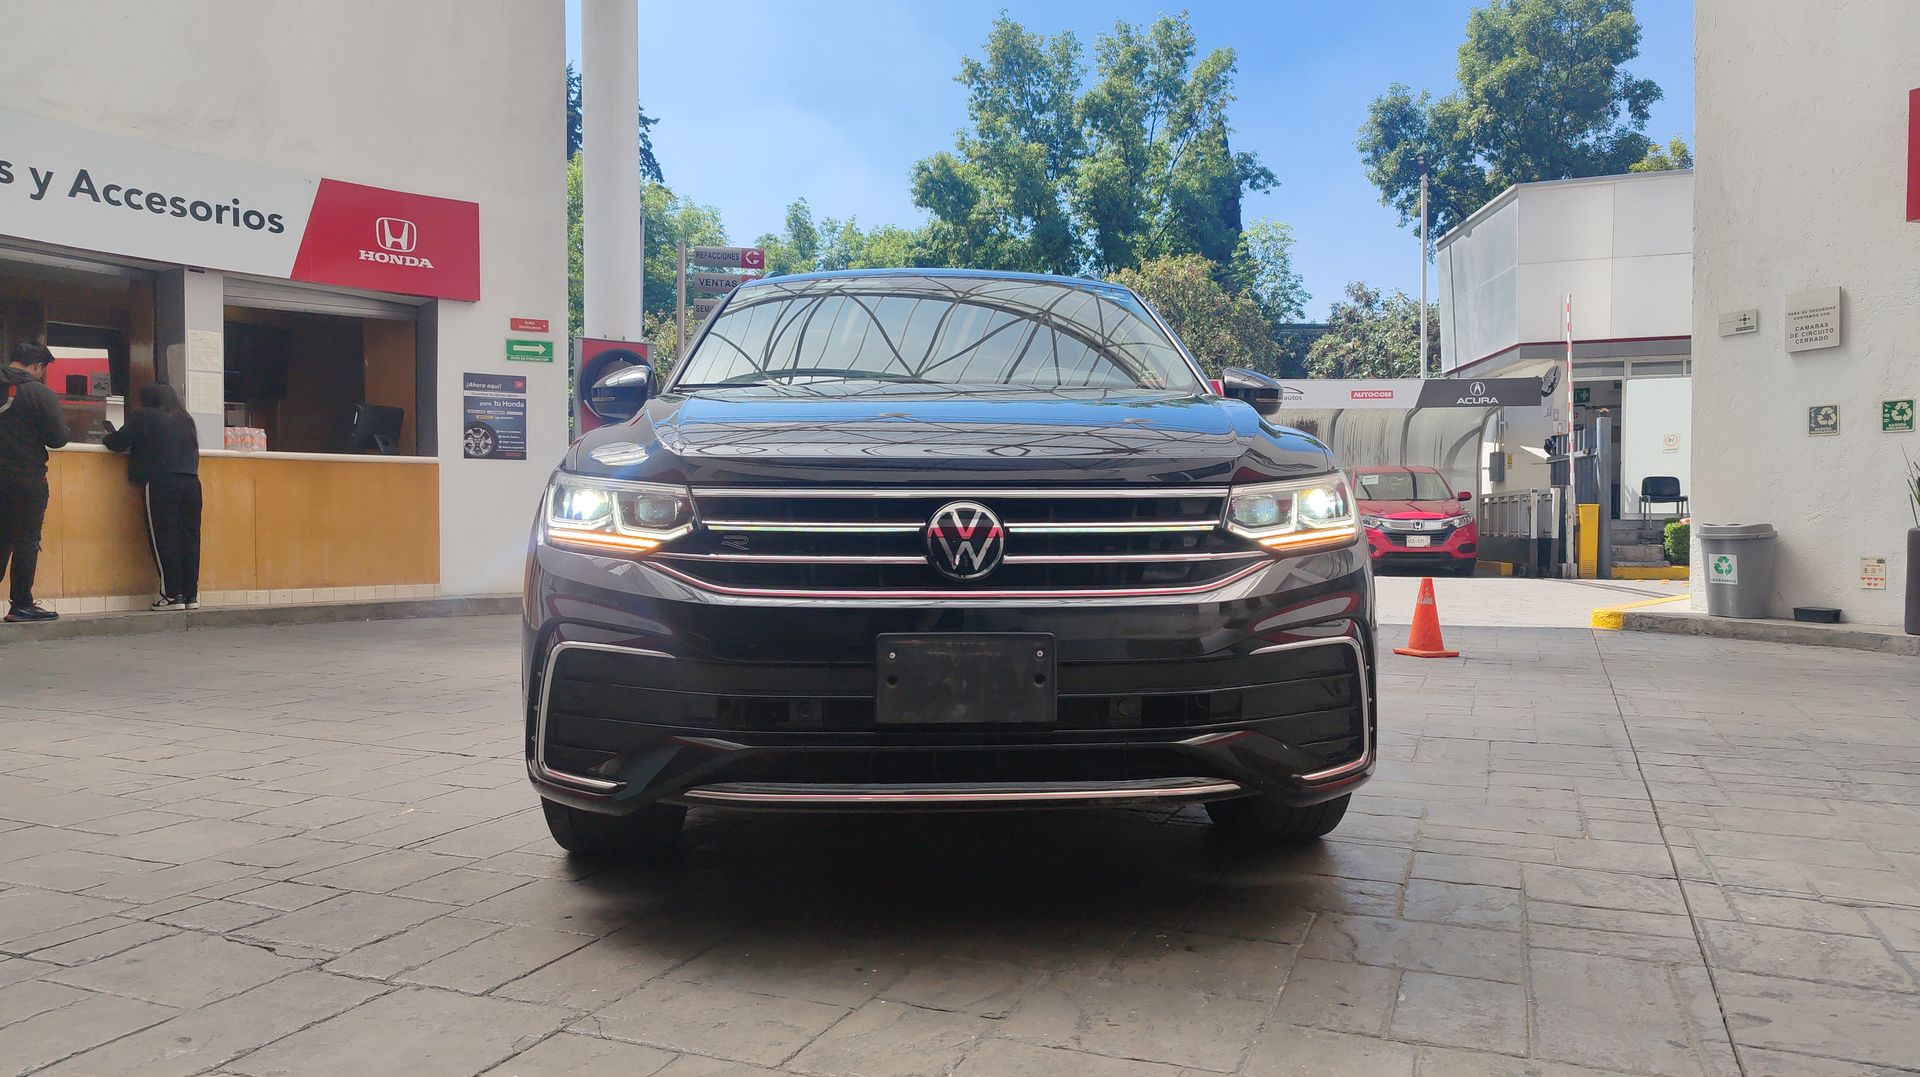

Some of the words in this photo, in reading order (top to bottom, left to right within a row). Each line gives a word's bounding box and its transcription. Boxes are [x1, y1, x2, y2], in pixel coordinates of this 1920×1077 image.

[29, 167, 54, 201] y
[67, 168, 285, 234] Accesorios
[358, 249, 435, 269] HONDA
[695, 251, 740, 261] REFACCIONES
[699, 278, 738, 288] VENTAS
[695, 304, 715, 313] SEMI
[1809, 305, 1837, 314] SEGURIDAD
[1793, 313, 1819, 321] CONTAMOS
[1794, 322, 1829, 332] CAMARAS
[1801, 327, 1835, 338] CIRCUITO
[1794, 335, 1829, 345] CERRADO
[502, 400, 525, 408] Honda
[1456, 397, 1499, 405] ACURA
